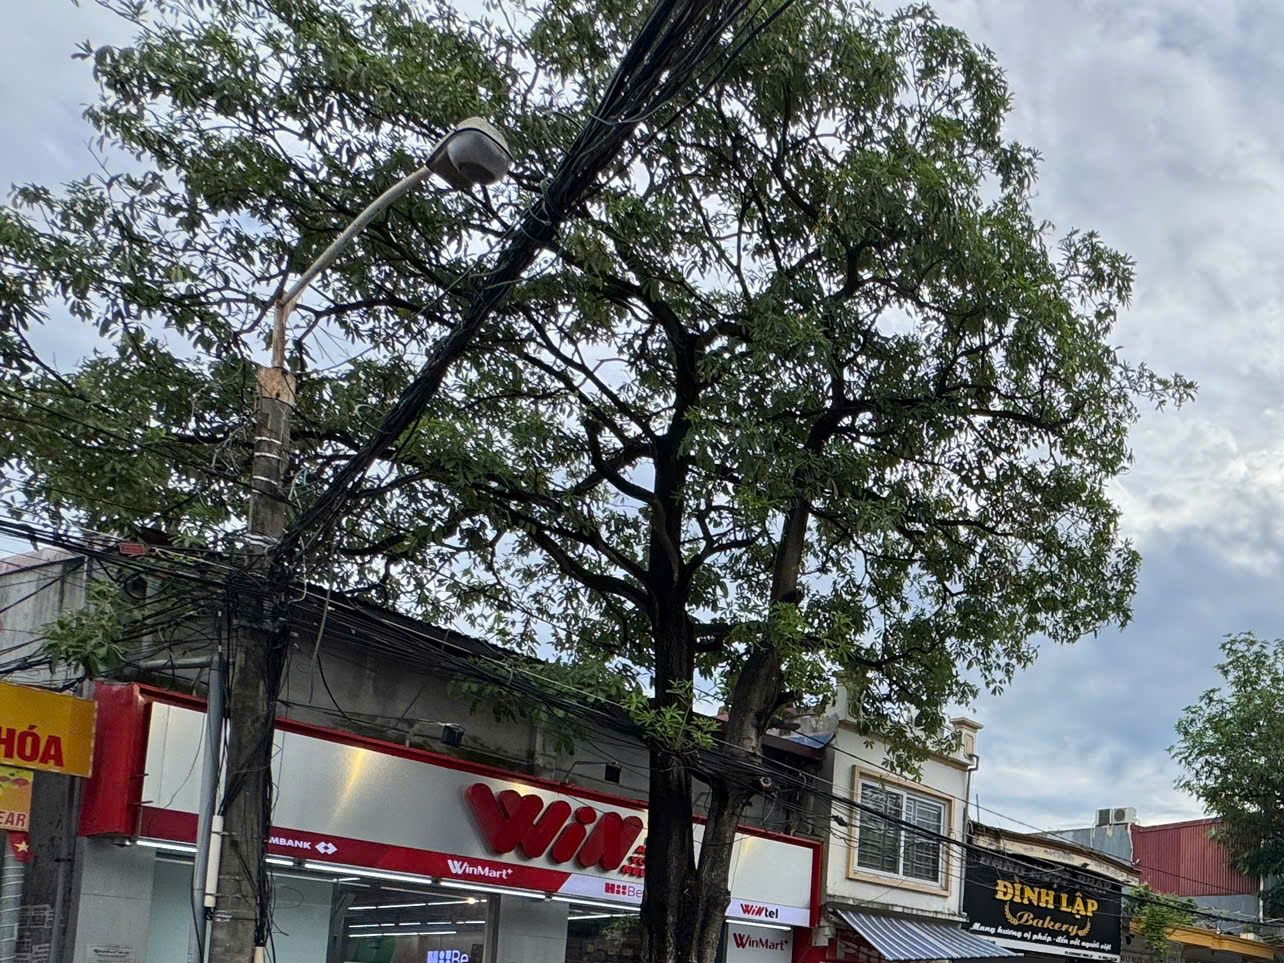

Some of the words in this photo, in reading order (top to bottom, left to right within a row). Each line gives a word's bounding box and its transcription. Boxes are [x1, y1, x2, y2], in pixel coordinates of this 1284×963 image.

[0, 811, 26, 827] EAR
[268, 836, 311, 849] MBANK
[970, 922, 996, 934] Mang
[1016, 911, 1078, 936] Bakery
